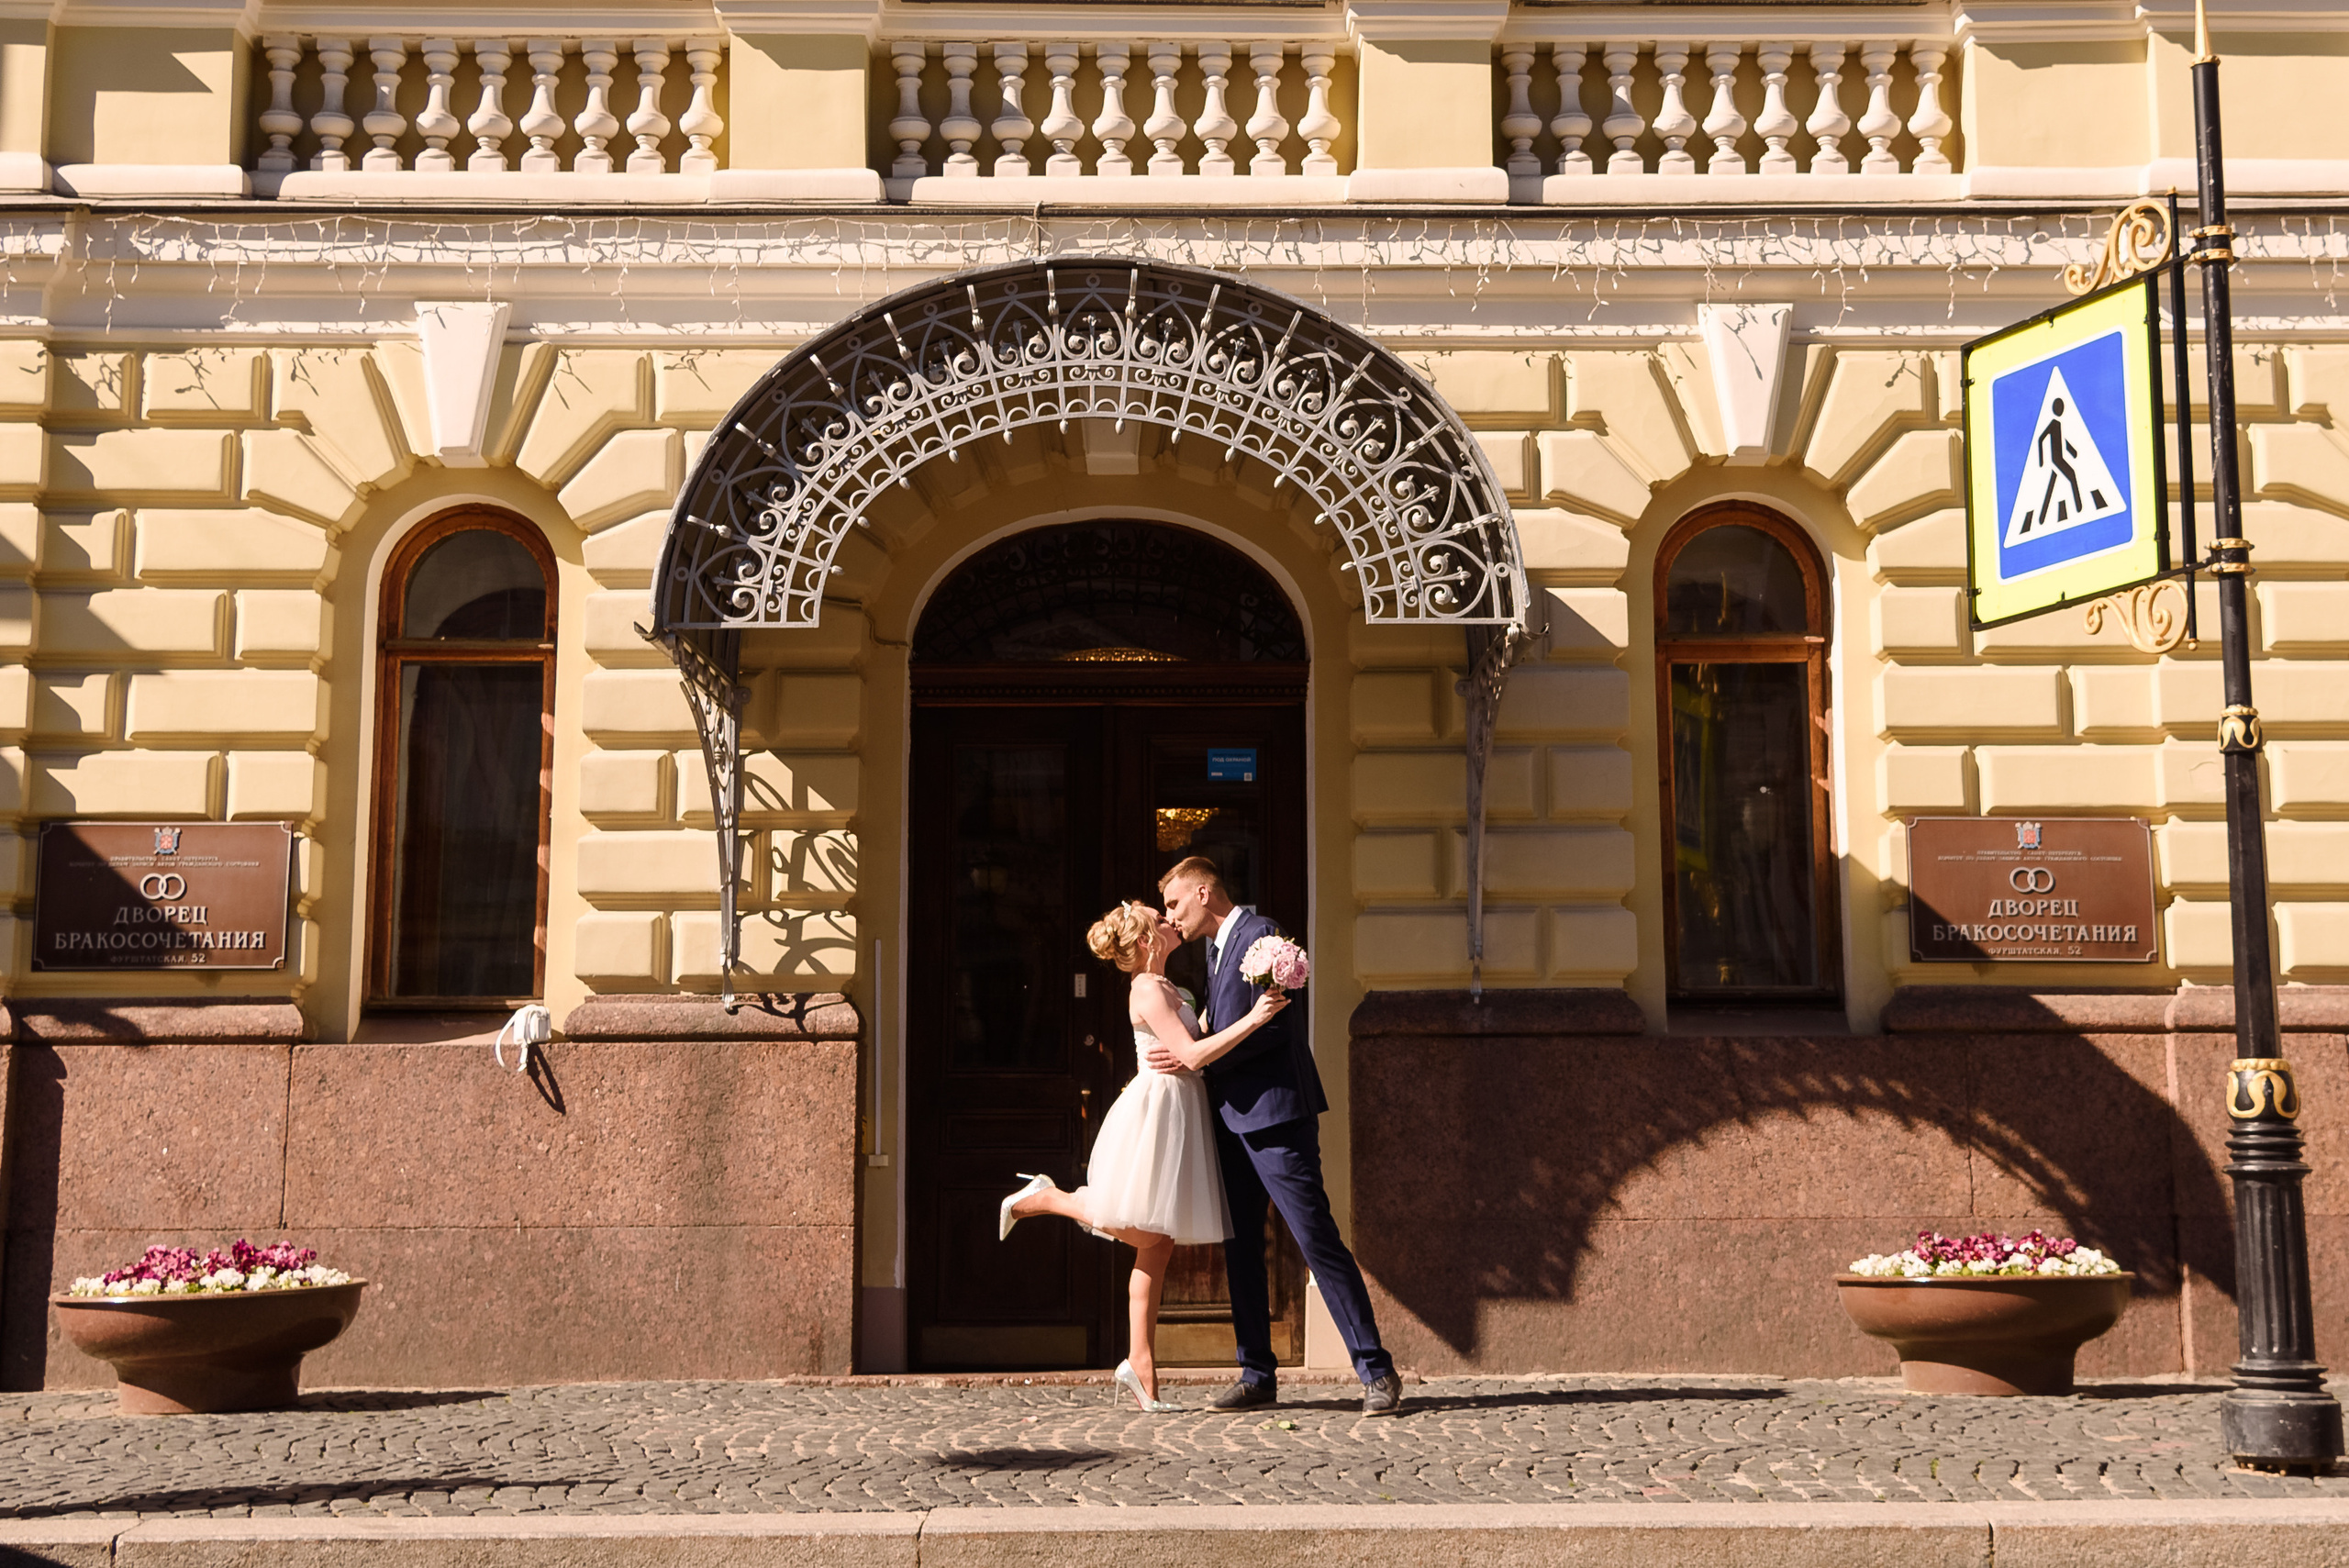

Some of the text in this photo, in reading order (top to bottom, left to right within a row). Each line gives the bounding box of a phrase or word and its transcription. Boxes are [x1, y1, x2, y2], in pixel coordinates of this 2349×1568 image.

[113, 906, 207, 925] ДВОРЕЦ
[1987, 899, 2079, 918] ДВОРЕЦ
[55, 931, 266, 950] БРАКОСОЧЕТАНИЯ
[1932, 924, 2138, 942] БРАКОСОЧЕТАНИЯ
[191, 952, 206, 963] 52
[2067, 946, 2082, 955] 52
